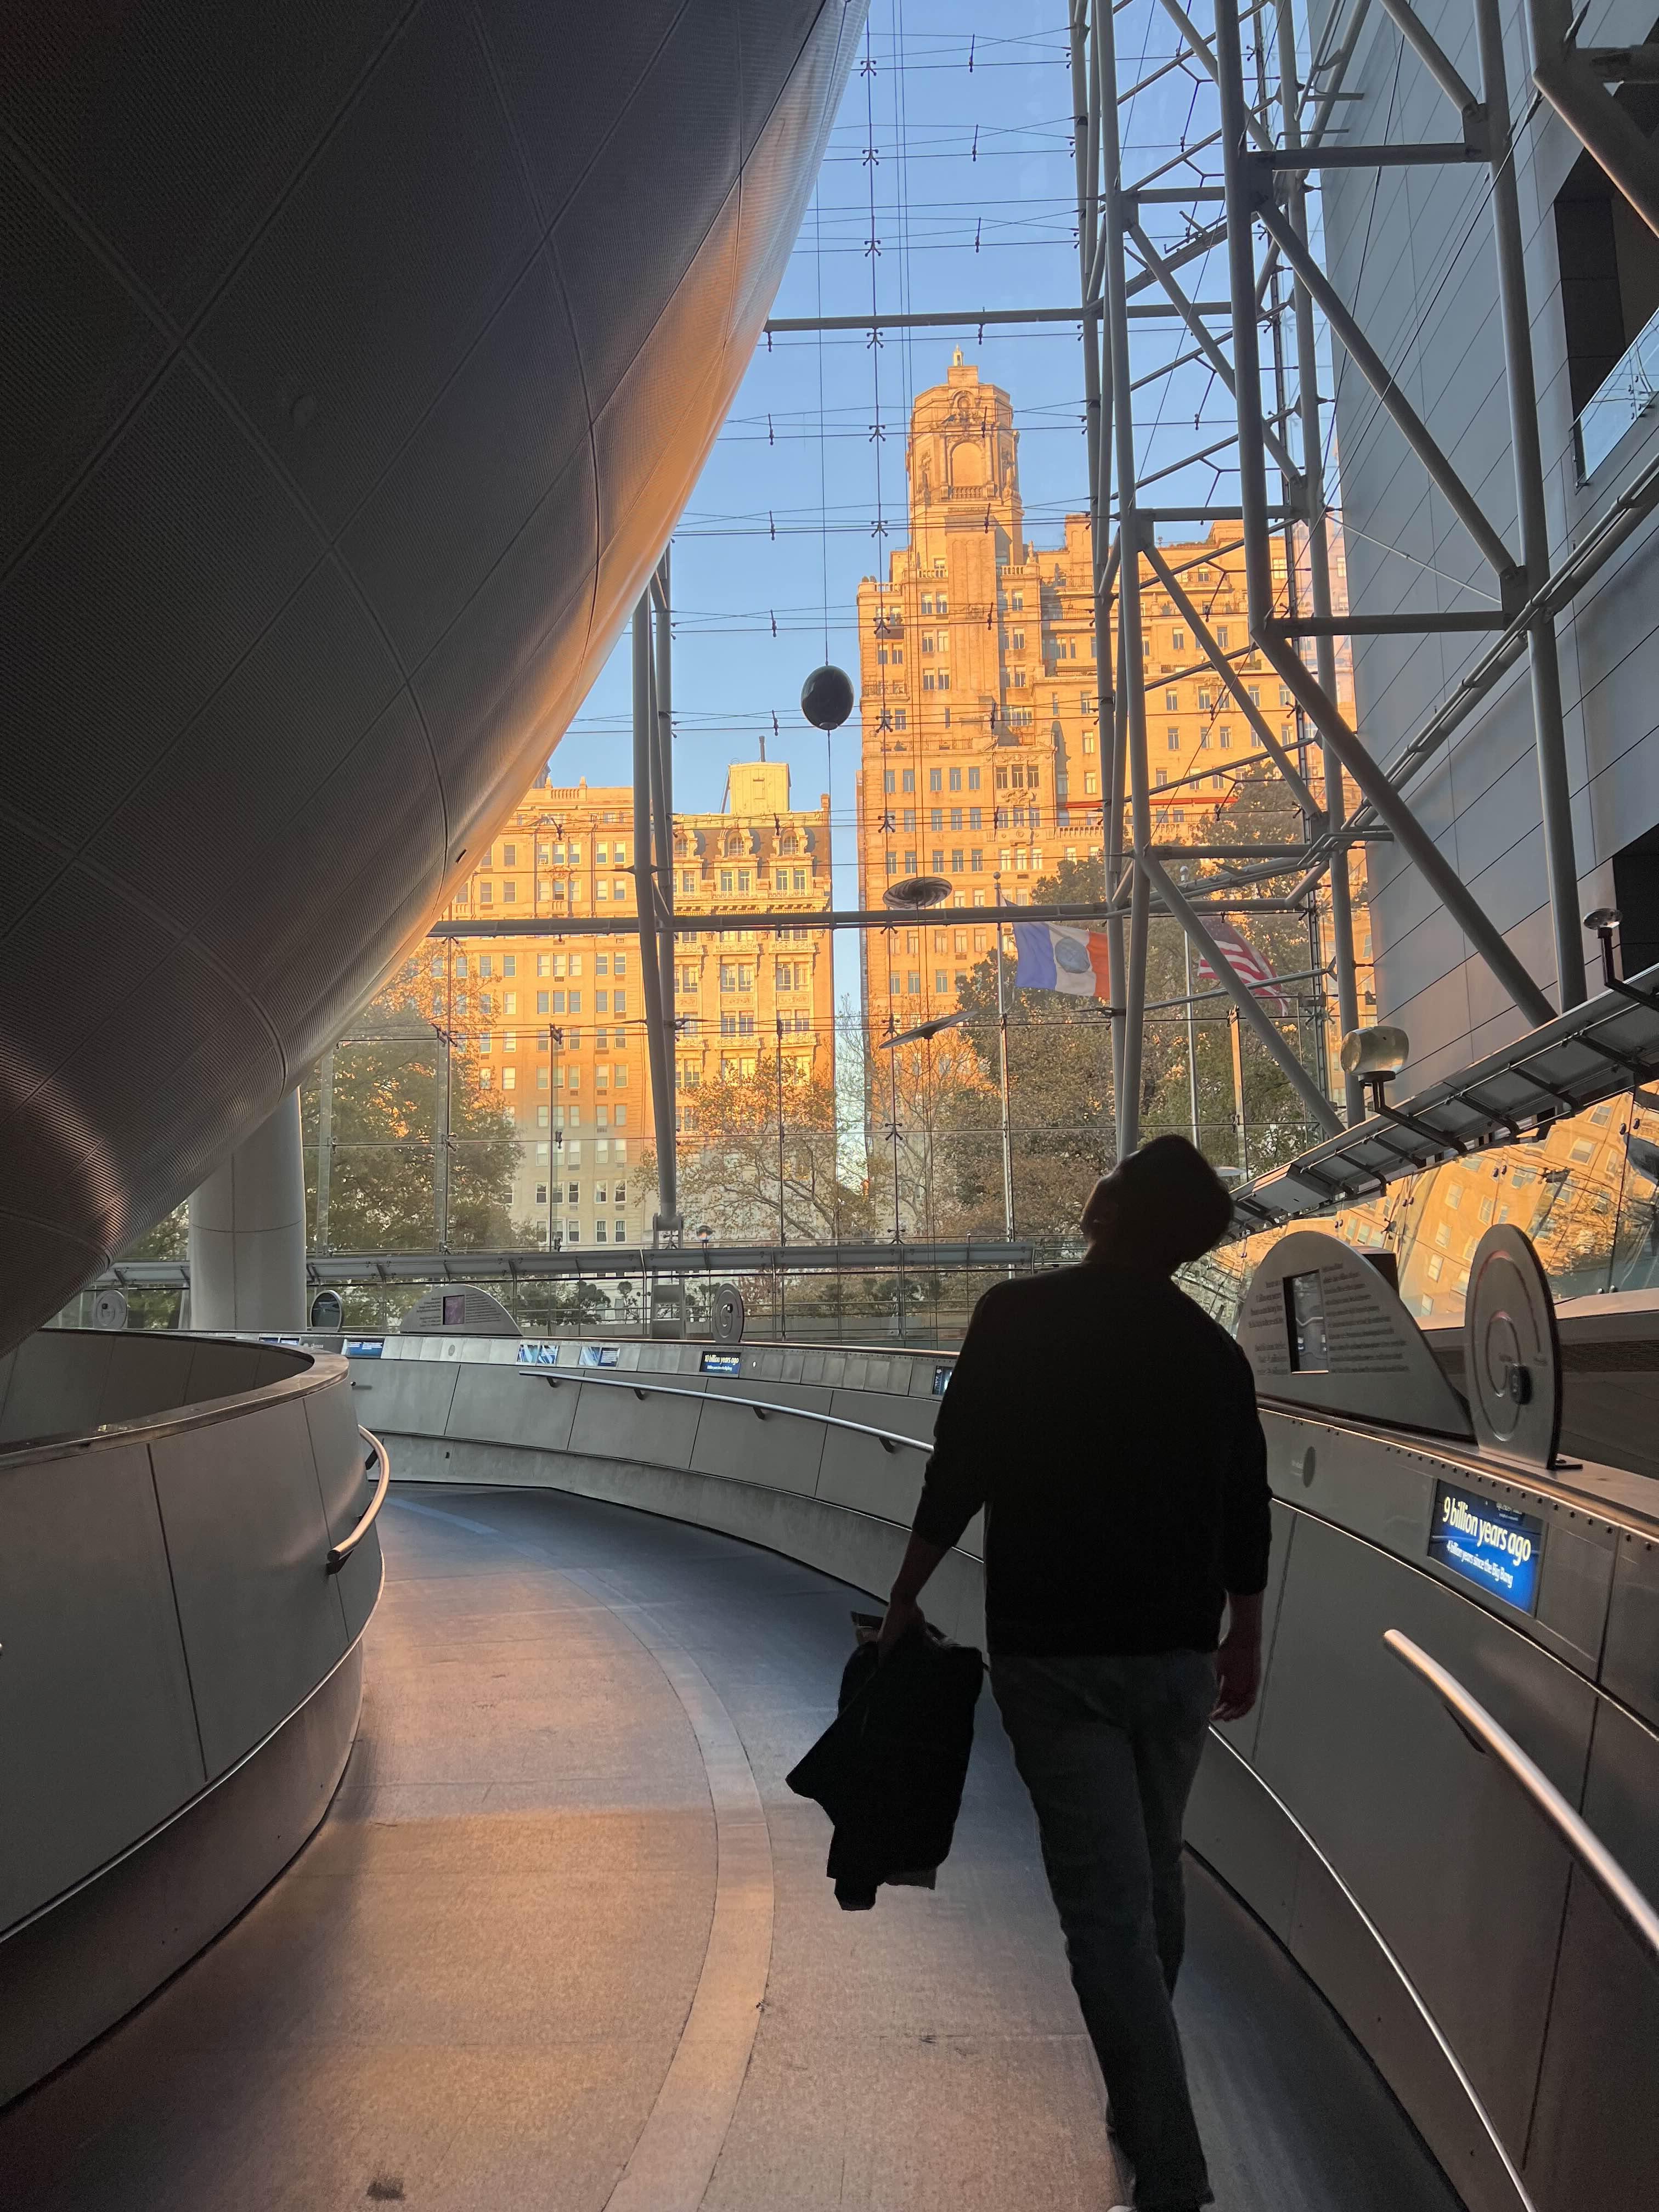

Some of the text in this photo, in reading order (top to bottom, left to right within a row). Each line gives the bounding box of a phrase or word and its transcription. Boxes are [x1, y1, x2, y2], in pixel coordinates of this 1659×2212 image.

[709, 1354, 720, 1363] billion
[731, 1357, 739, 1365] ago
[1443, 1496, 1531, 1566] 9 billion years ago
[1450, 1540, 1463, 1558] billion
[1461, 1551, 1474, 1564] years
[1473, 1554, 1485, 1570] since
[1484, 1559, 1493, 1573] the
[1492, 1562, 1500, 1581] Big
[1500, 1566, 1513, 1588] Bang
